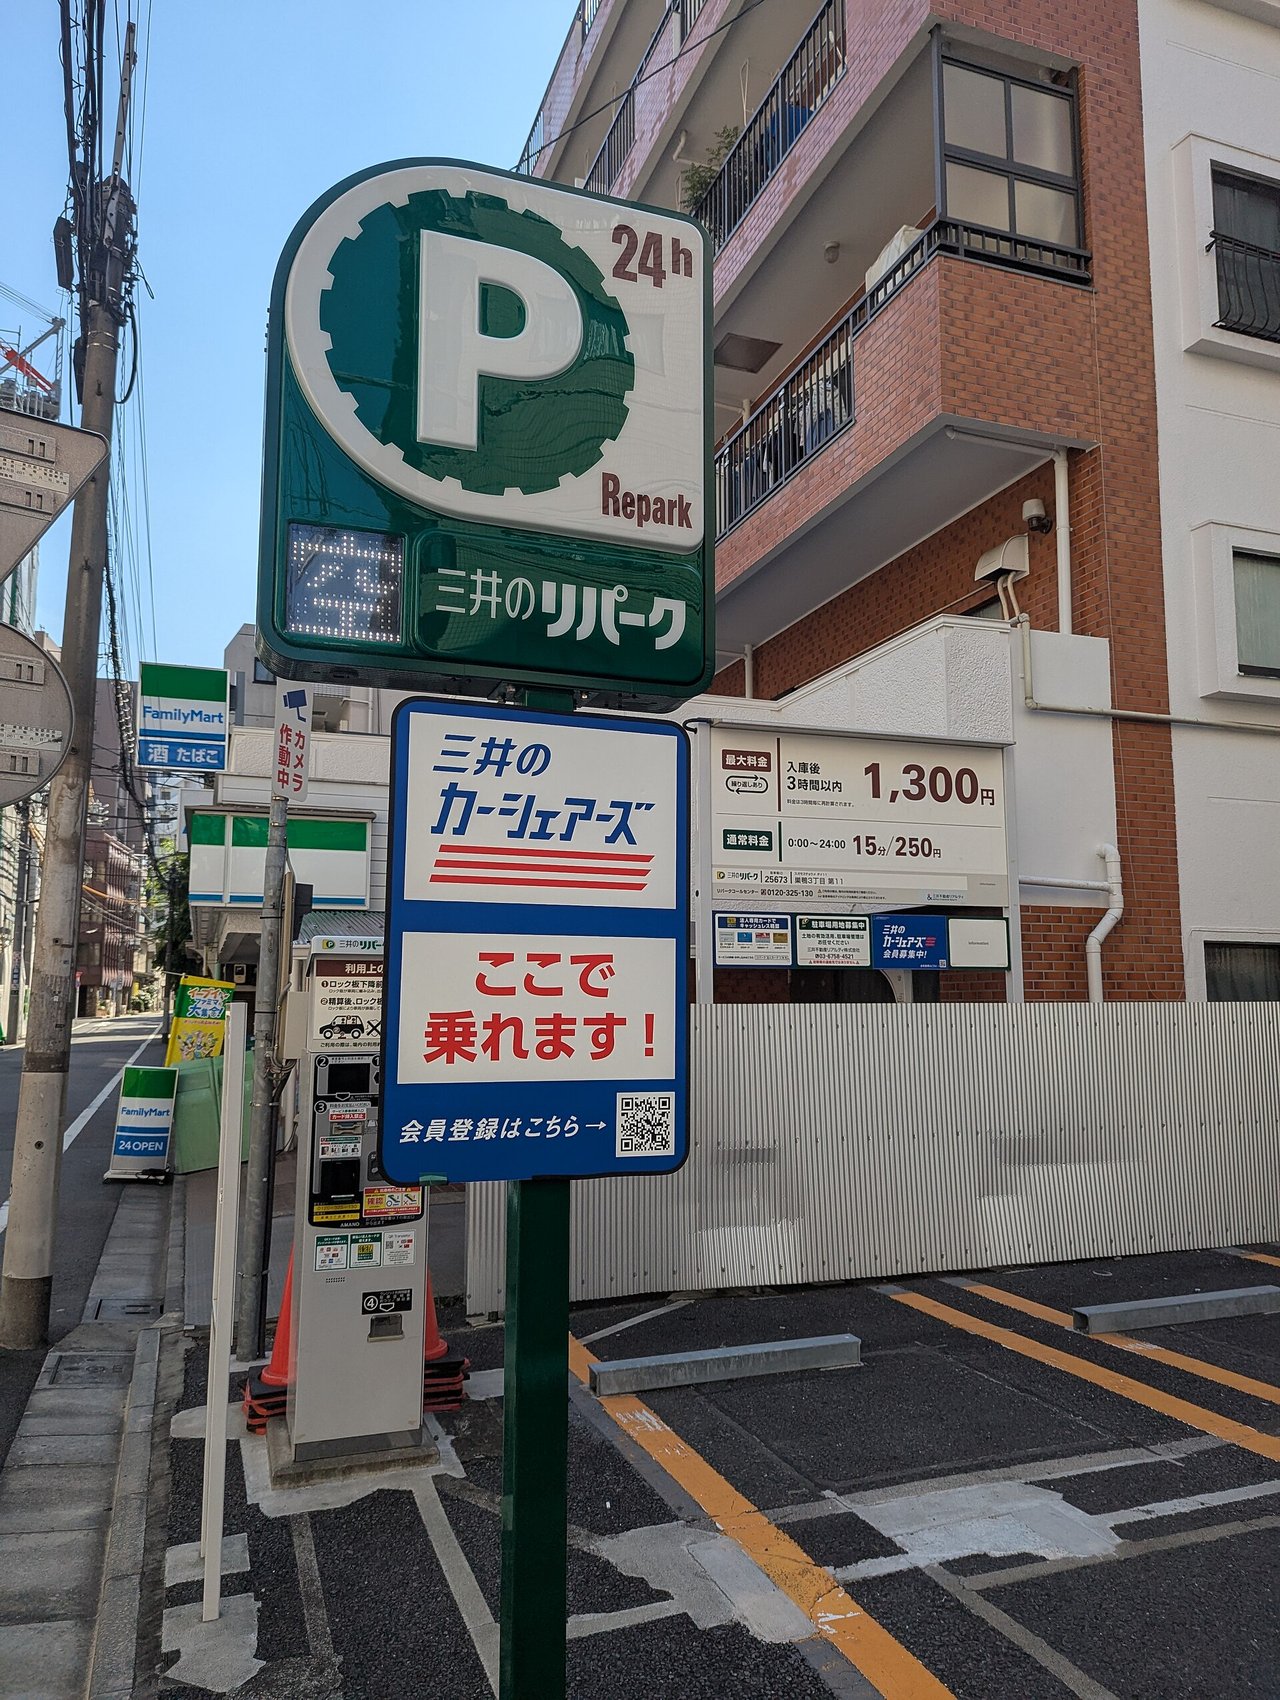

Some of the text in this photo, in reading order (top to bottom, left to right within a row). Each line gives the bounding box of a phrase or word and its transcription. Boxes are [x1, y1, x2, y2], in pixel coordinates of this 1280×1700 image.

[611, 223, 693, 289] 24h
[416, 228, 584, 452] P
[602, 472, 692, 529] Repark
[435, 568, 687, 650] 三井のリパーク
[143, 705, 224, 725] FamilyMart
[148, 744, 219, 764] 酒 たばこ
[277, 723, 293, 790] 作動中
[292, 730, 306, 792] カメラ
[432, 734, 552, 777] 三井の
[725, 754, 768, 768] 最大料金
[786, 761, 820, 774] 入庫後
[786, 776, 843, 792] 3時間以内
[864, 762, 995, 806] 1,300円
[430, 782, 656, 846] カーシェアーズ
[726, 833, 769, 848] 通常料金
[764, 875, 788, 884] 25673
[339, 940, 384, 950] 三井のリパー
[882, 924, 906, 934] 三井の
[475, 951, 617, 998] ここで
[423, 1010, 655, 1065] 乗れます！
[121, 1107, 170, 1117] FamilyMart
[399, 1115, 580, 1144] 会員登録はこちら
